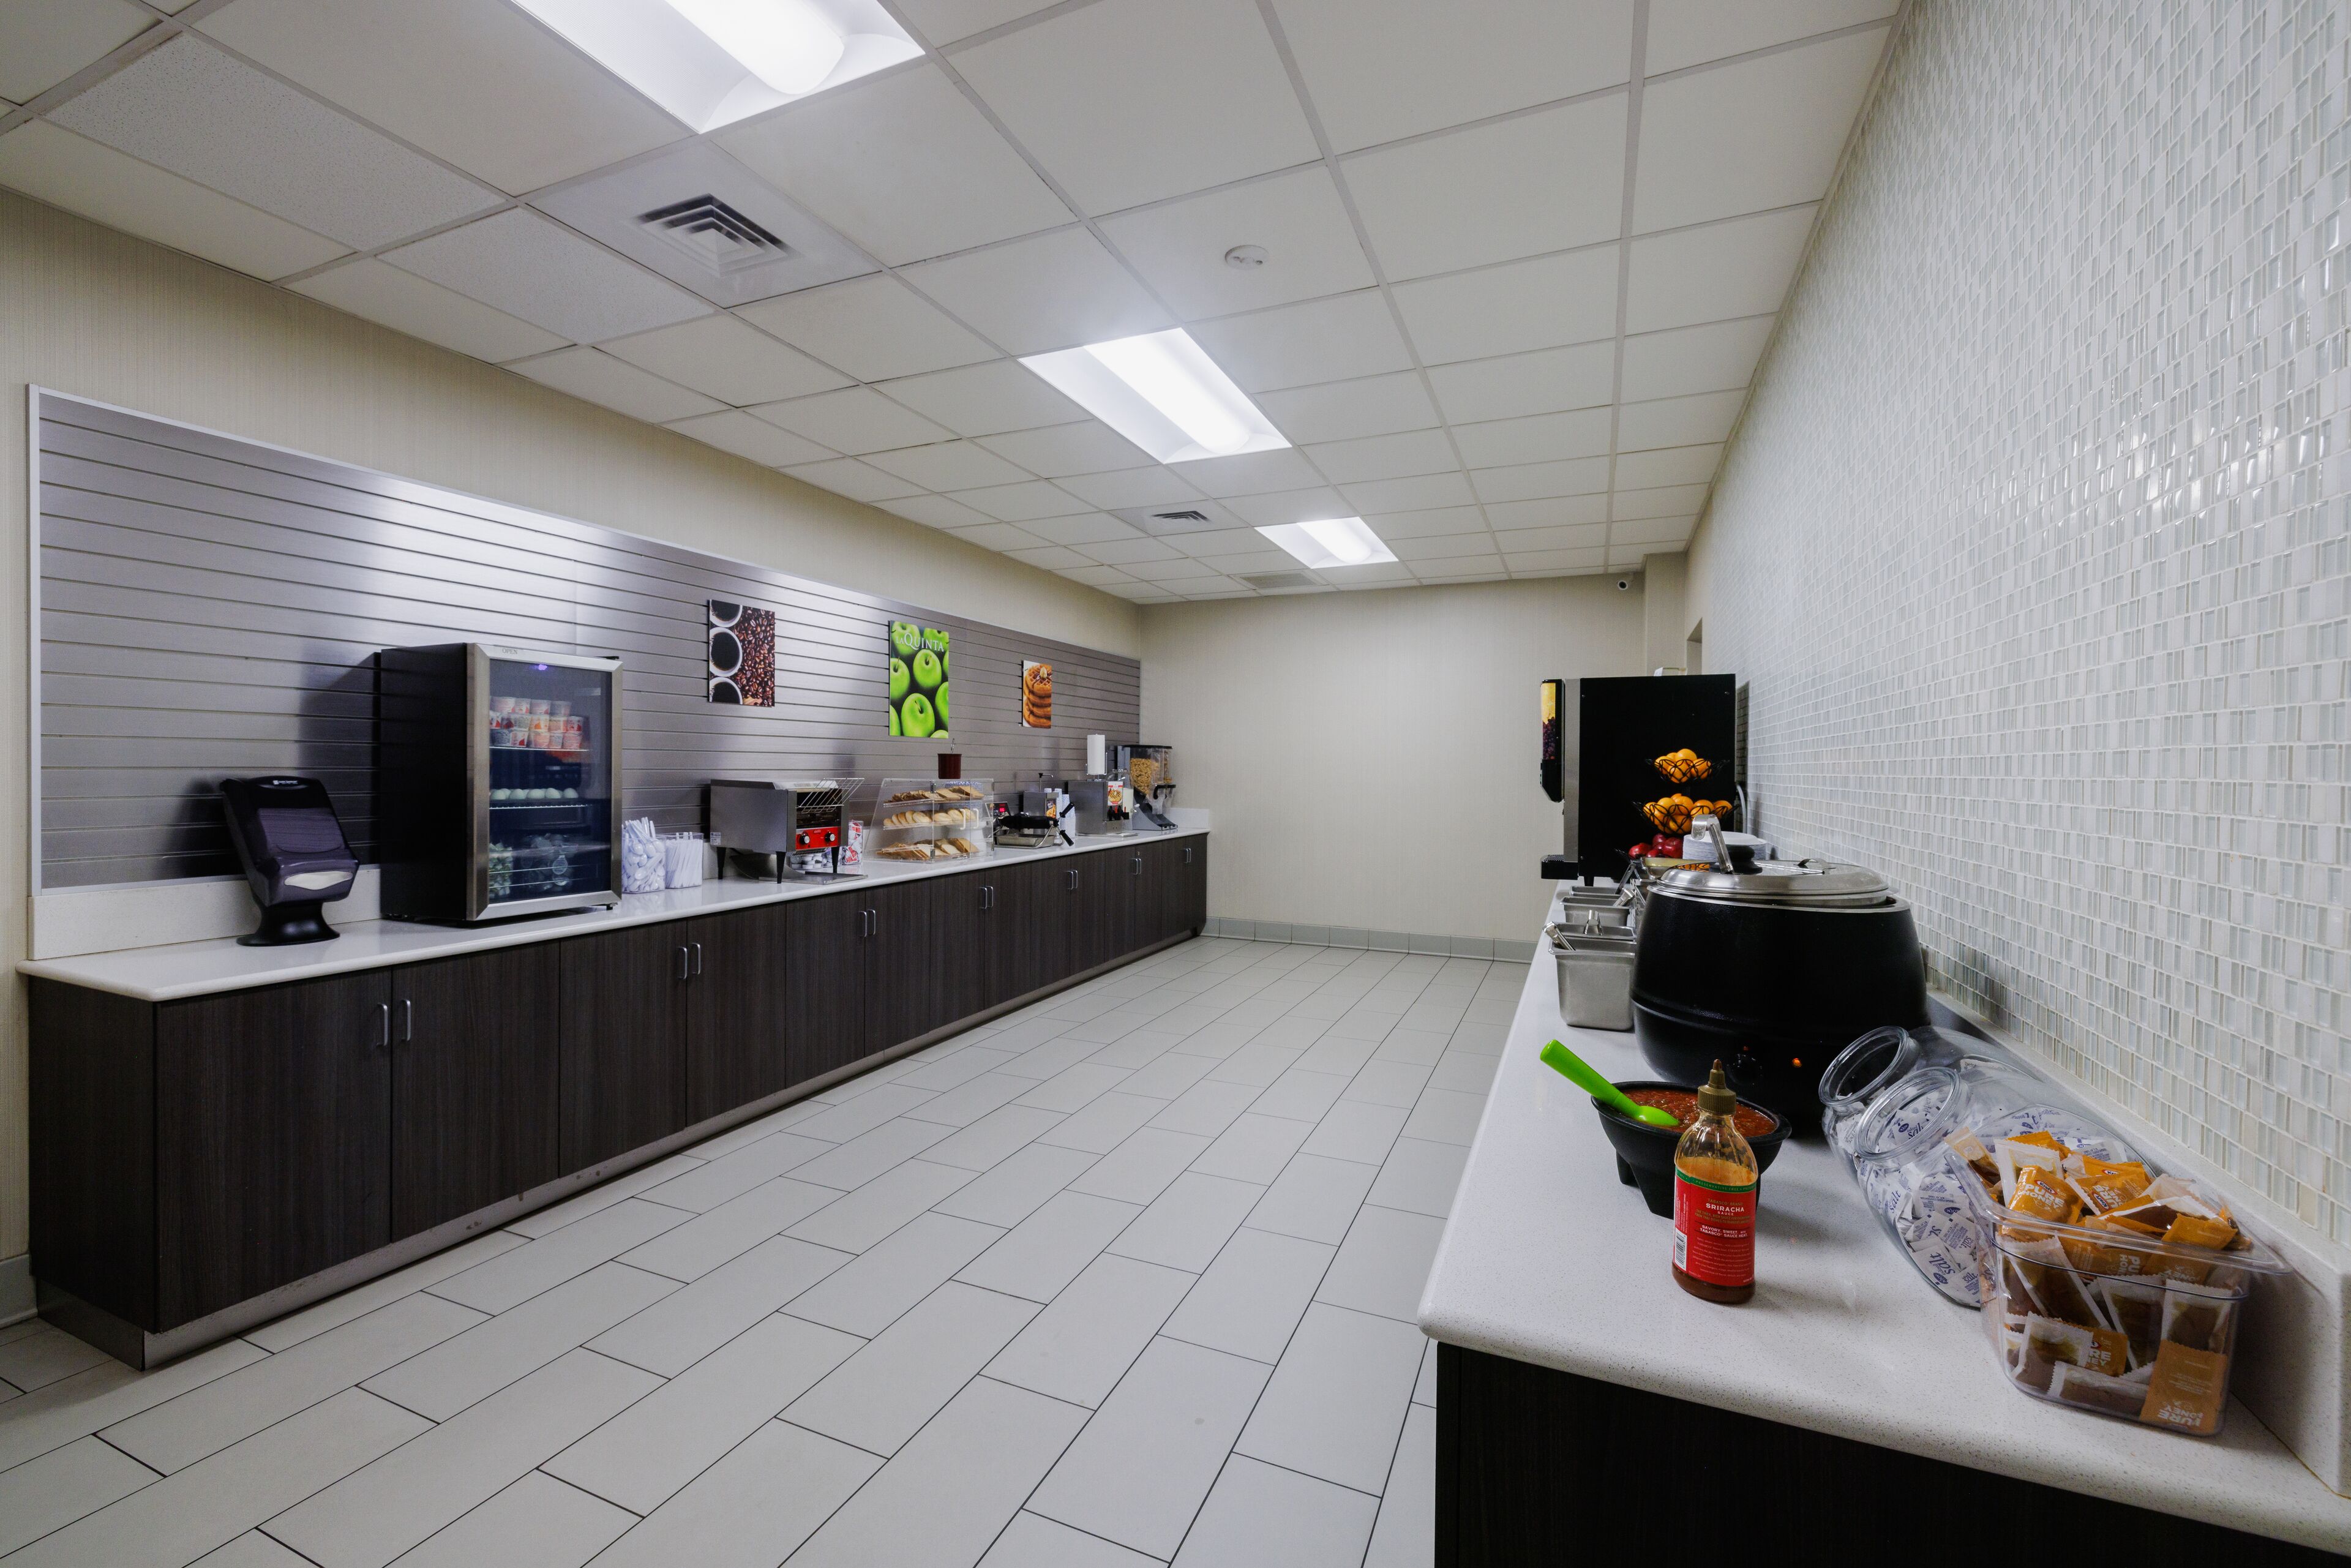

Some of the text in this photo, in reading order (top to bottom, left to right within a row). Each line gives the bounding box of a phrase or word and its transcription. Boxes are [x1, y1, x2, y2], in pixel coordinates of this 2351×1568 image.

[896, 632, 945, 652] LA QUINTA
[2025, 1184, 2065, 1207] PURE
[2039, 1182, 2053, 1194] Kraft
[1889, 1190, 1901, 1210] salt
[2018, 1190, 2061, 1209] HONEY
[2093, 1185, 2118, 1209] URE
[2095, 1195, 2108, 1207] Kraft
[1706, 1203, 1744, 1212] SRIRACHA
[1960, 1236, 1972, 1248] salt
[1929, 1252, 1955, 1274] salt
[1963, 1272, 1978, 1283] salt
[2089, 1349, 2112, 1362] RE
